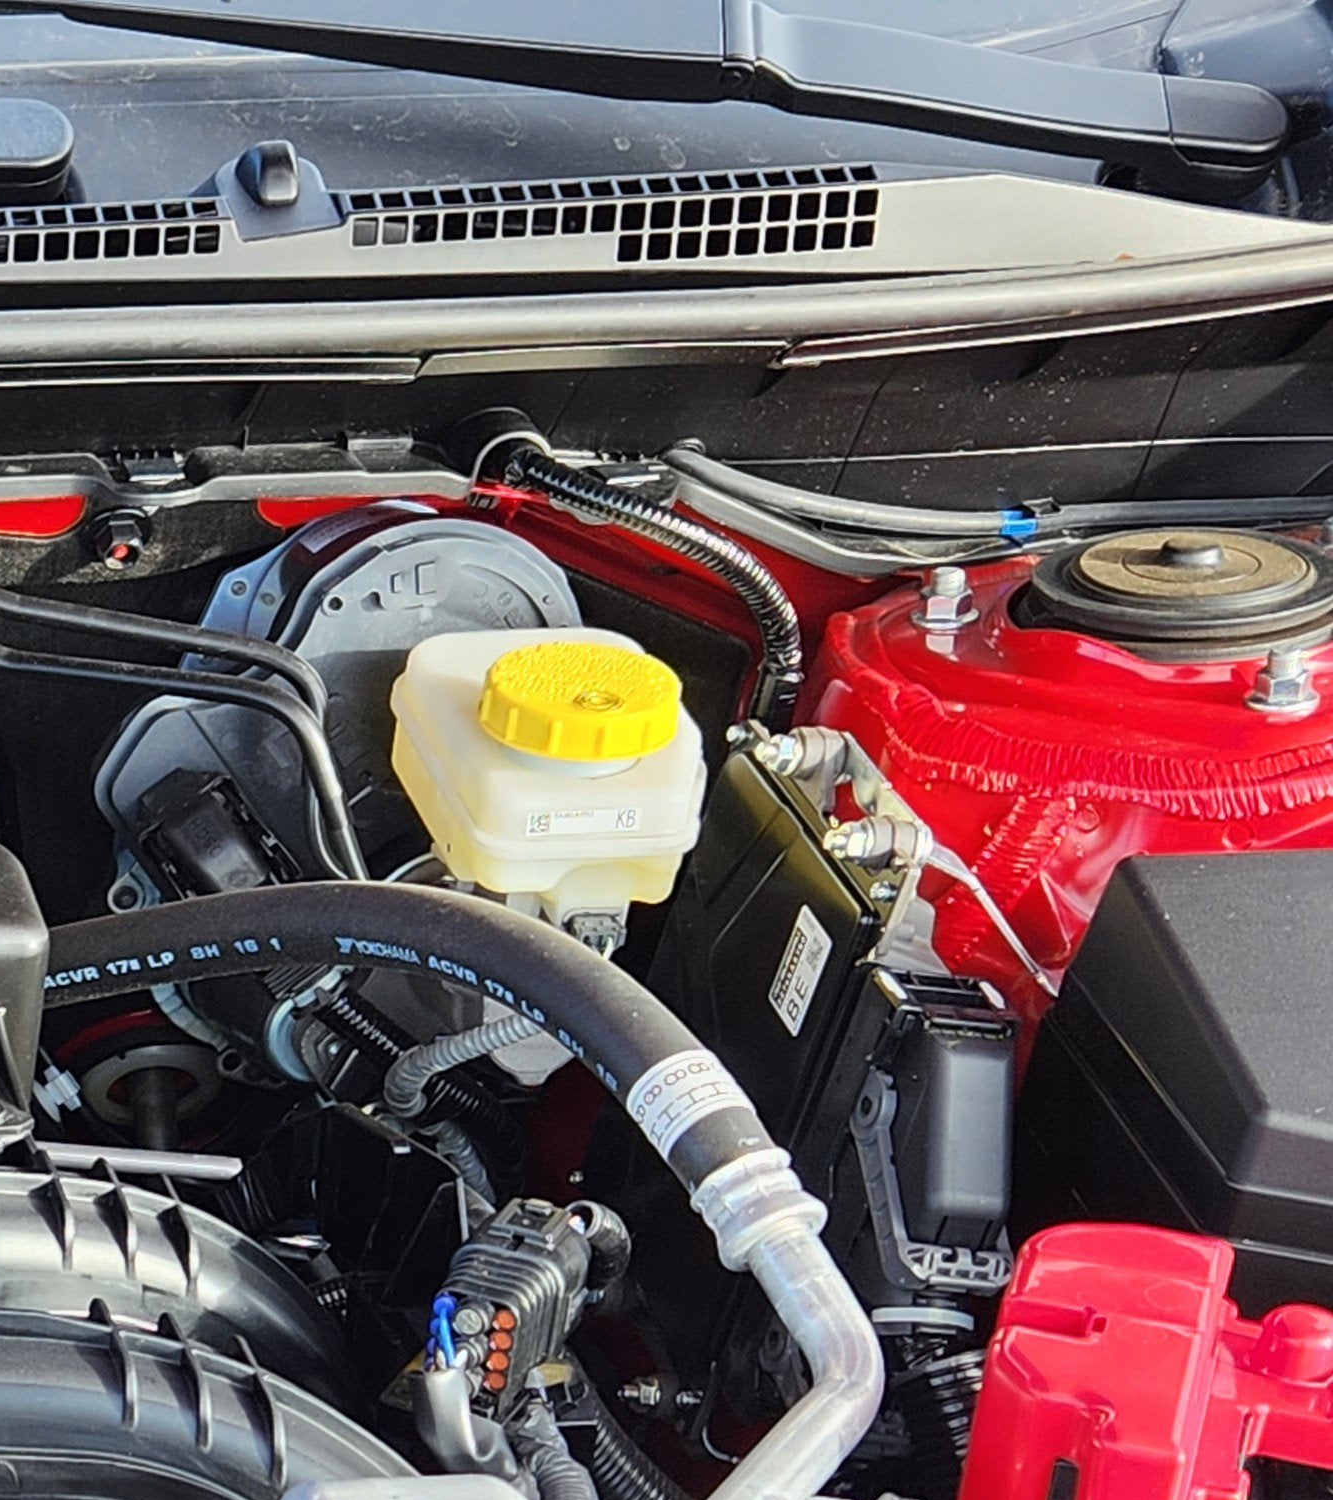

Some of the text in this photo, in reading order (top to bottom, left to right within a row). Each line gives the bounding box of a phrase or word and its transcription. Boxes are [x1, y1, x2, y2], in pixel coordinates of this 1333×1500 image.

[43, 966, 100, 990] ACVR
[146, 951, 176, 970] LP
[351, 939, 422, 966] YOKOHAMA
[427, 955, 479, 987] ACVR
[520, 999, 546, 1024] LP
